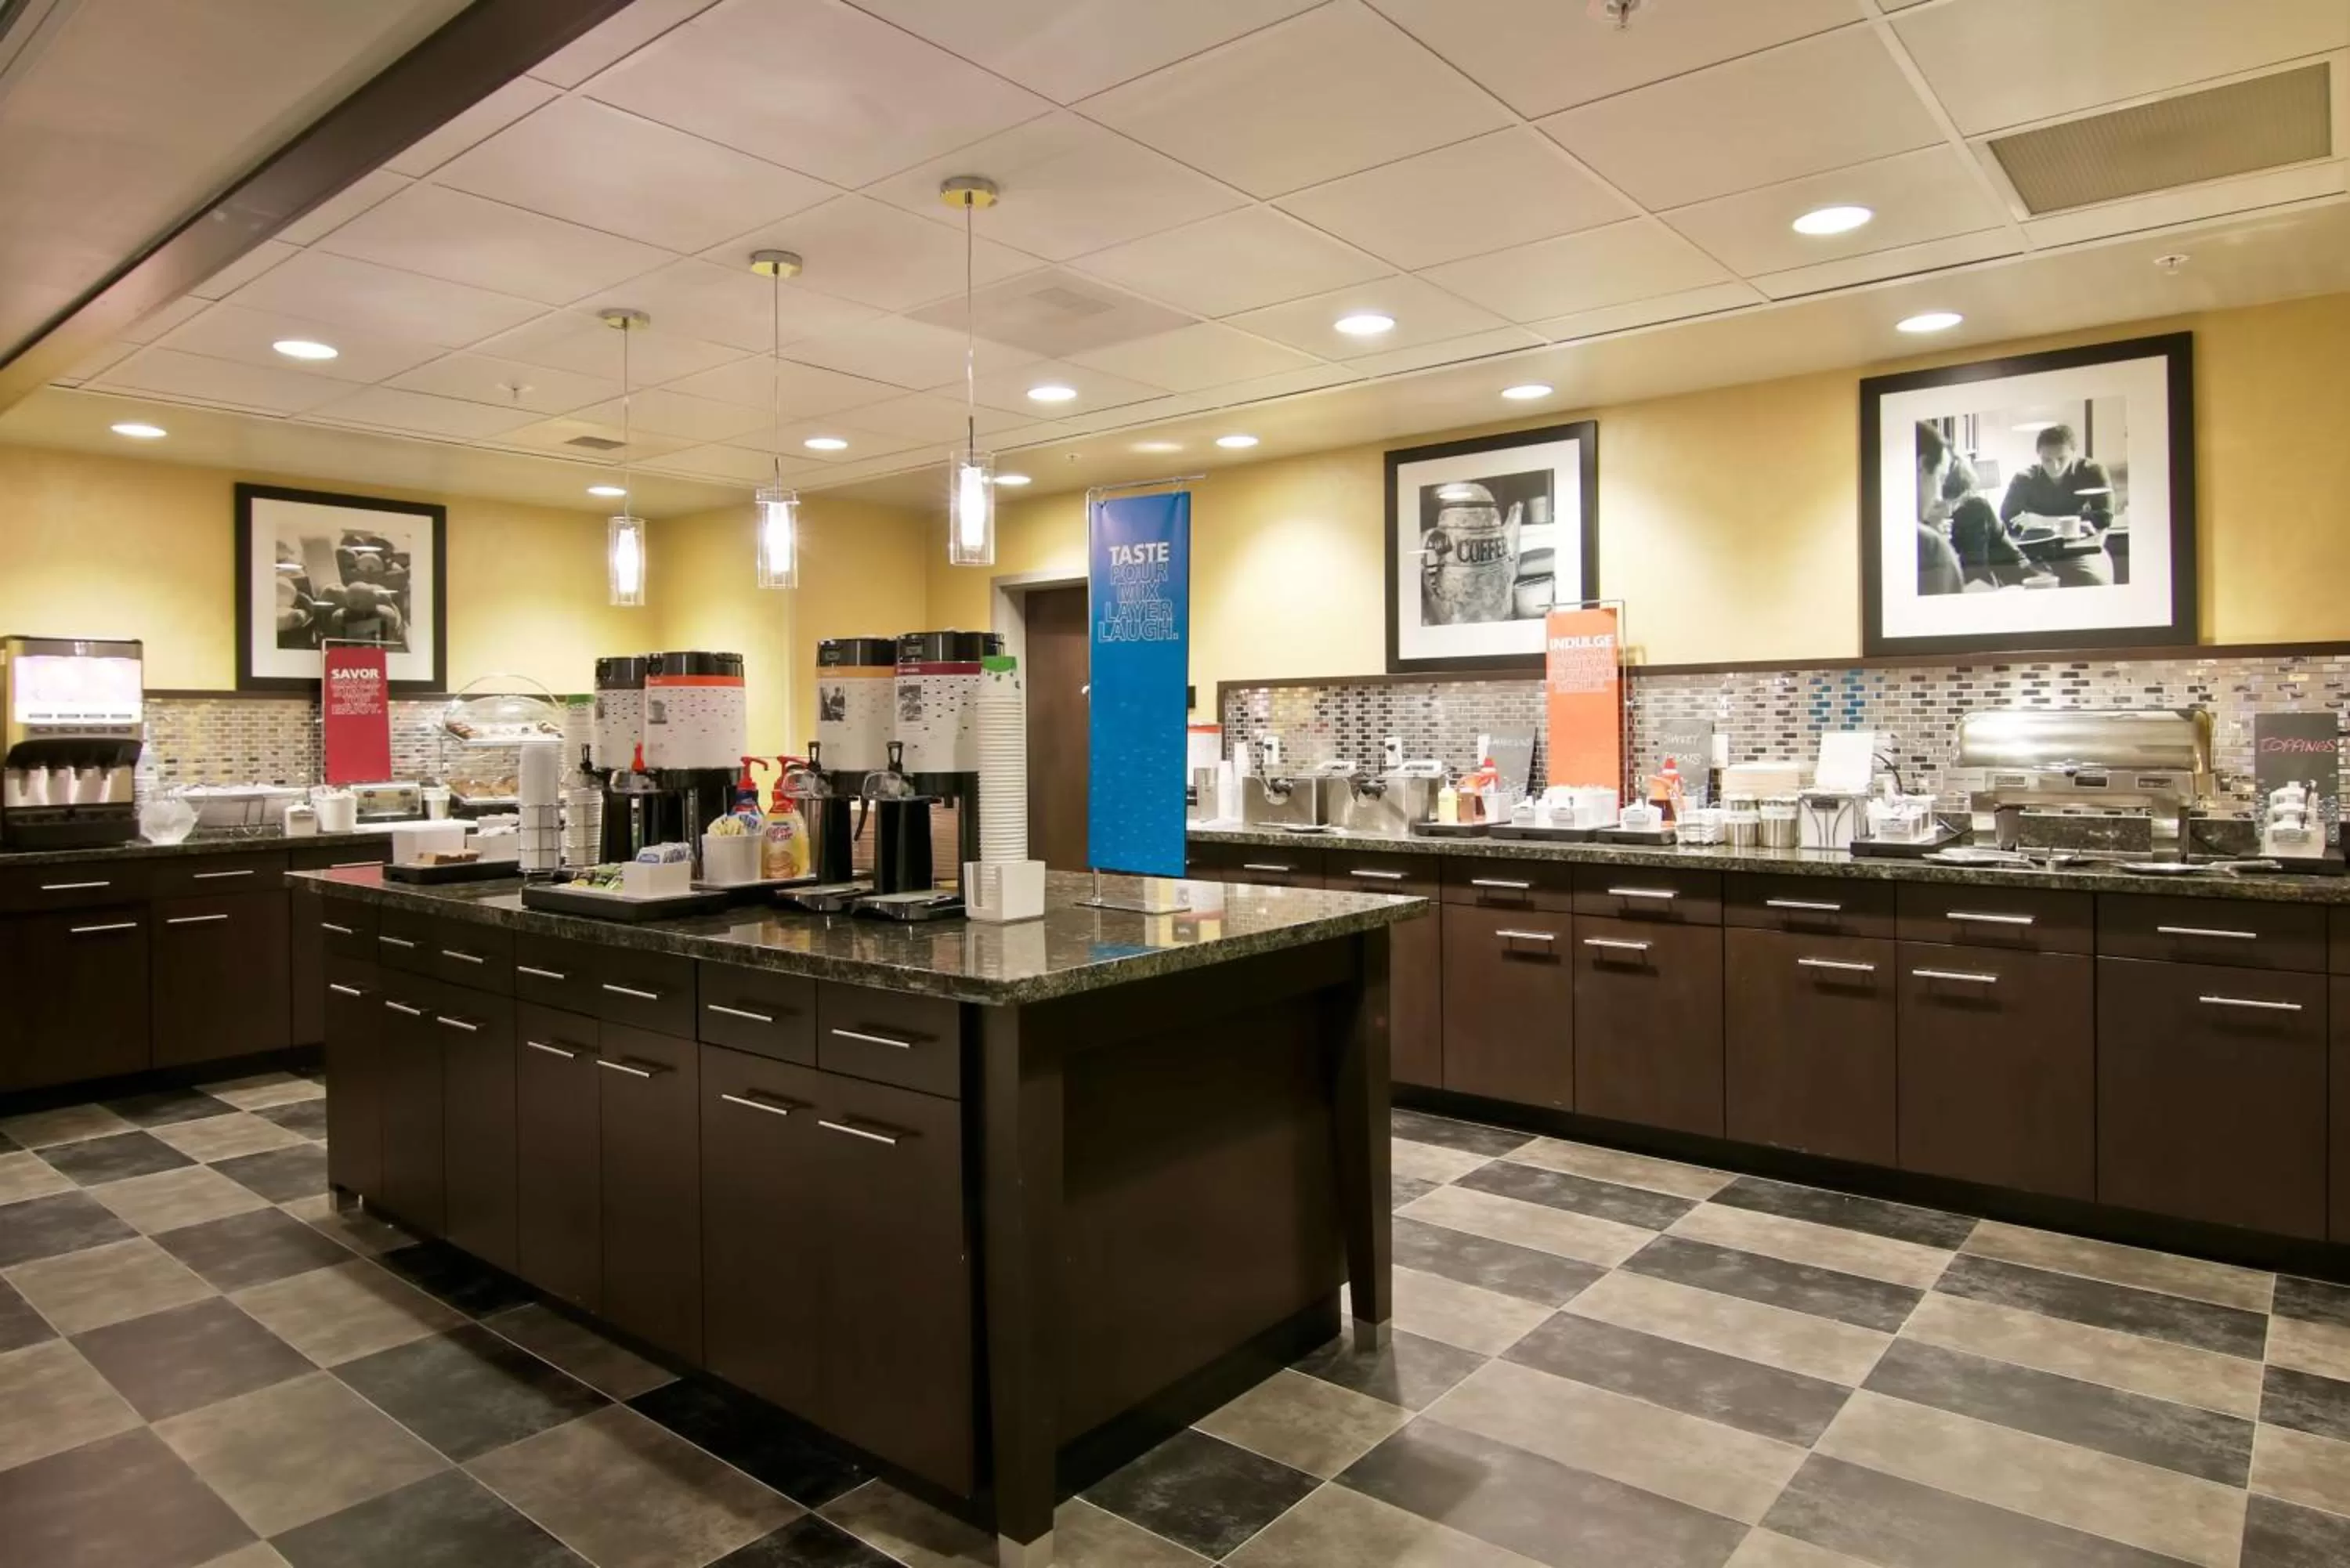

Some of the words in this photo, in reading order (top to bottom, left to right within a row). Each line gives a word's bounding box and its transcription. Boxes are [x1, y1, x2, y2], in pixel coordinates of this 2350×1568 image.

[1108, 542, 1170, 565] TASTE
[1110, 562, 1168, 584] POUR
[1116, 583, 1159, 603] MIX
[1104, 600, 1173, 623] LAYER
[1098, 618, 1179, 642] LAUGH.
[1549, 635, 1614, 649] INDULGE
[331, 668, 380, 679] SAVOR
[2259, 737, 2337, 753] TOPPINGS
